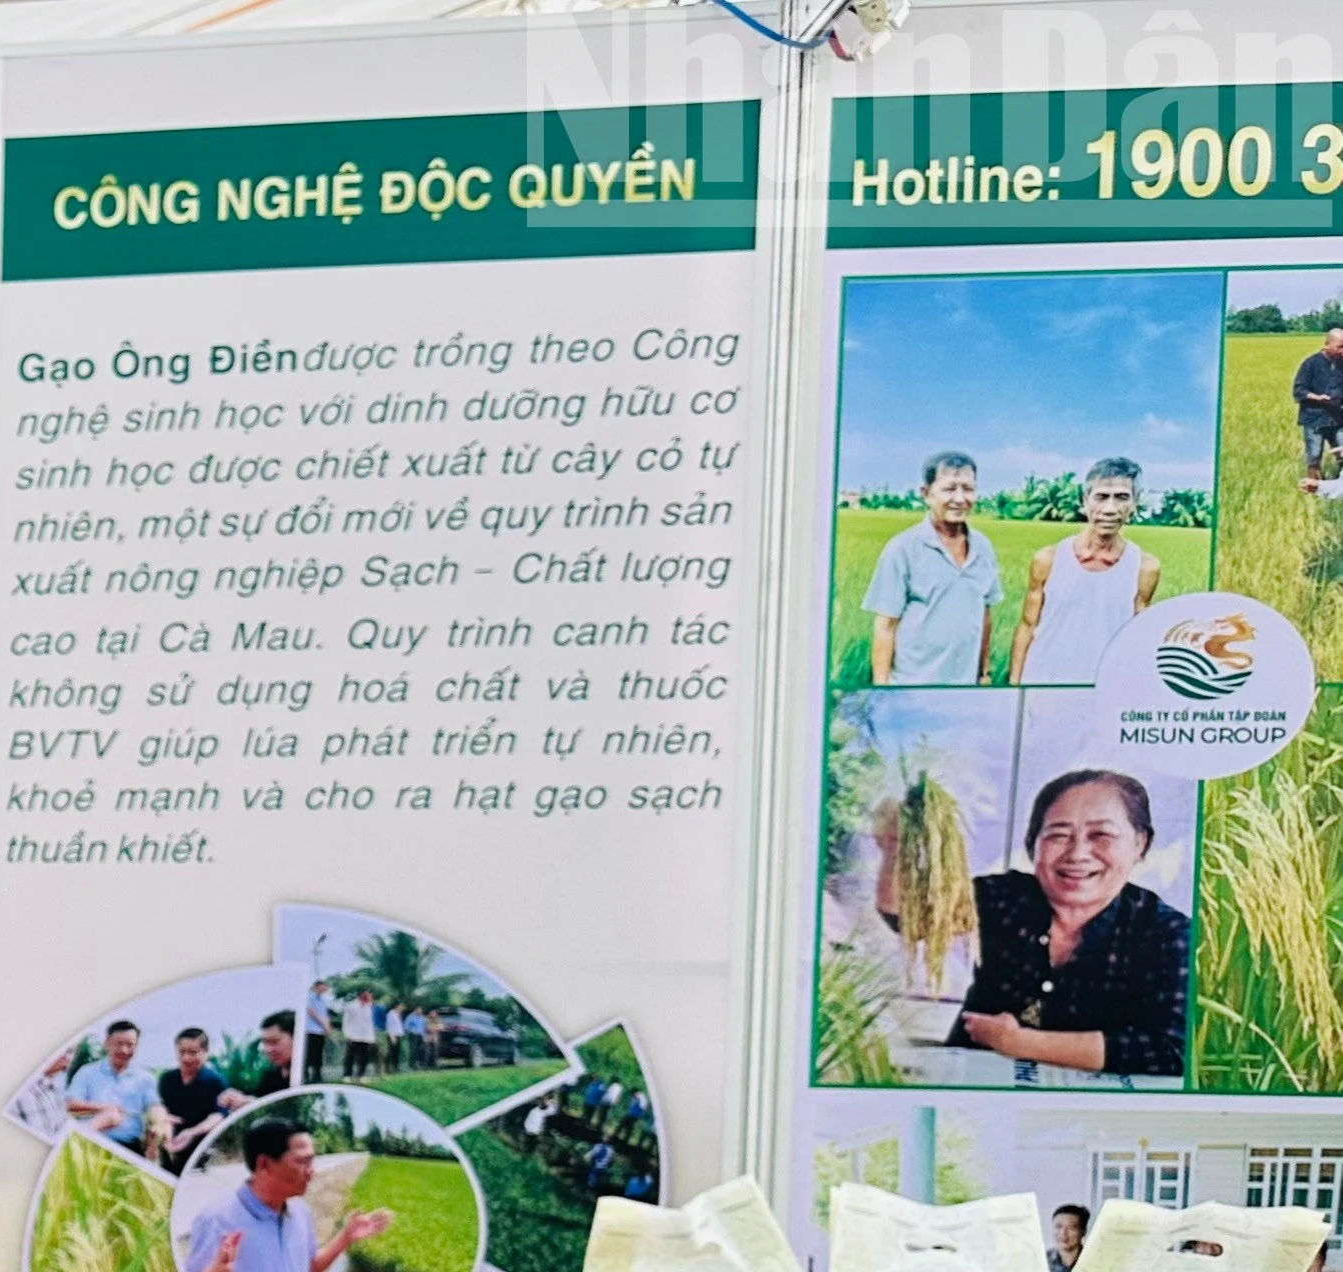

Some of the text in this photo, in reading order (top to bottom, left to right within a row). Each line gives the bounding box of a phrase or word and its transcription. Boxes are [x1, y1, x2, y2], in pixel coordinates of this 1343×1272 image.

[53, 140, 697, 232] CÔNG NGHỆ ĐỘC QUYỀN
[852, 122, 1343, 208] Hotline: 1900 3
[18, 353, 96, 388] Gạo
[112, 341, 190, 384] Ông
[529, 333, 615, 364] theo
[633, 328, 739, 366] Công
[17, 404, 110, 444] nghệ
[122, 403, 201, 433] sinh
[215, 400, 284, 434] học
[300, 395, 356, 426] với
[367, 392, 447, 425] dinh
[463, 389, 586, 426] dưỡng
[690, 388, 741, 415] cơ
[15, 436, 741, 492] sinh học được chiết xuất từ cây cỏ tự
[14, 511, 125, 545] nhiên,
[138, 508, 211, 544] một
[219, 508, 268, 542] sự
[275, 496, 333, 536] đổi
[480, 504, 553, 537] quy
[563, 496, 650, 529] trình
[661, 490, 733, 527] sản
[12, 547, 731, 599] xuất nông nghiệp Sạch Chất lượng
[9, 612, 731, 660] cao tại Cà Mau. Quy trình canh tác
[9, 664, 728, 715] không sử dụng hoá chất và thuốc
[8, 716, 721, 767] BVTV giúp lúa phát triển tự nhiên,
[1120, 727, 1286, 744] MISUN GROUP
[6, 779, 723, 818] khoẻ mạnh và cho ra hạt gạo sạch
[116, 829, 213, 864] khiết.
